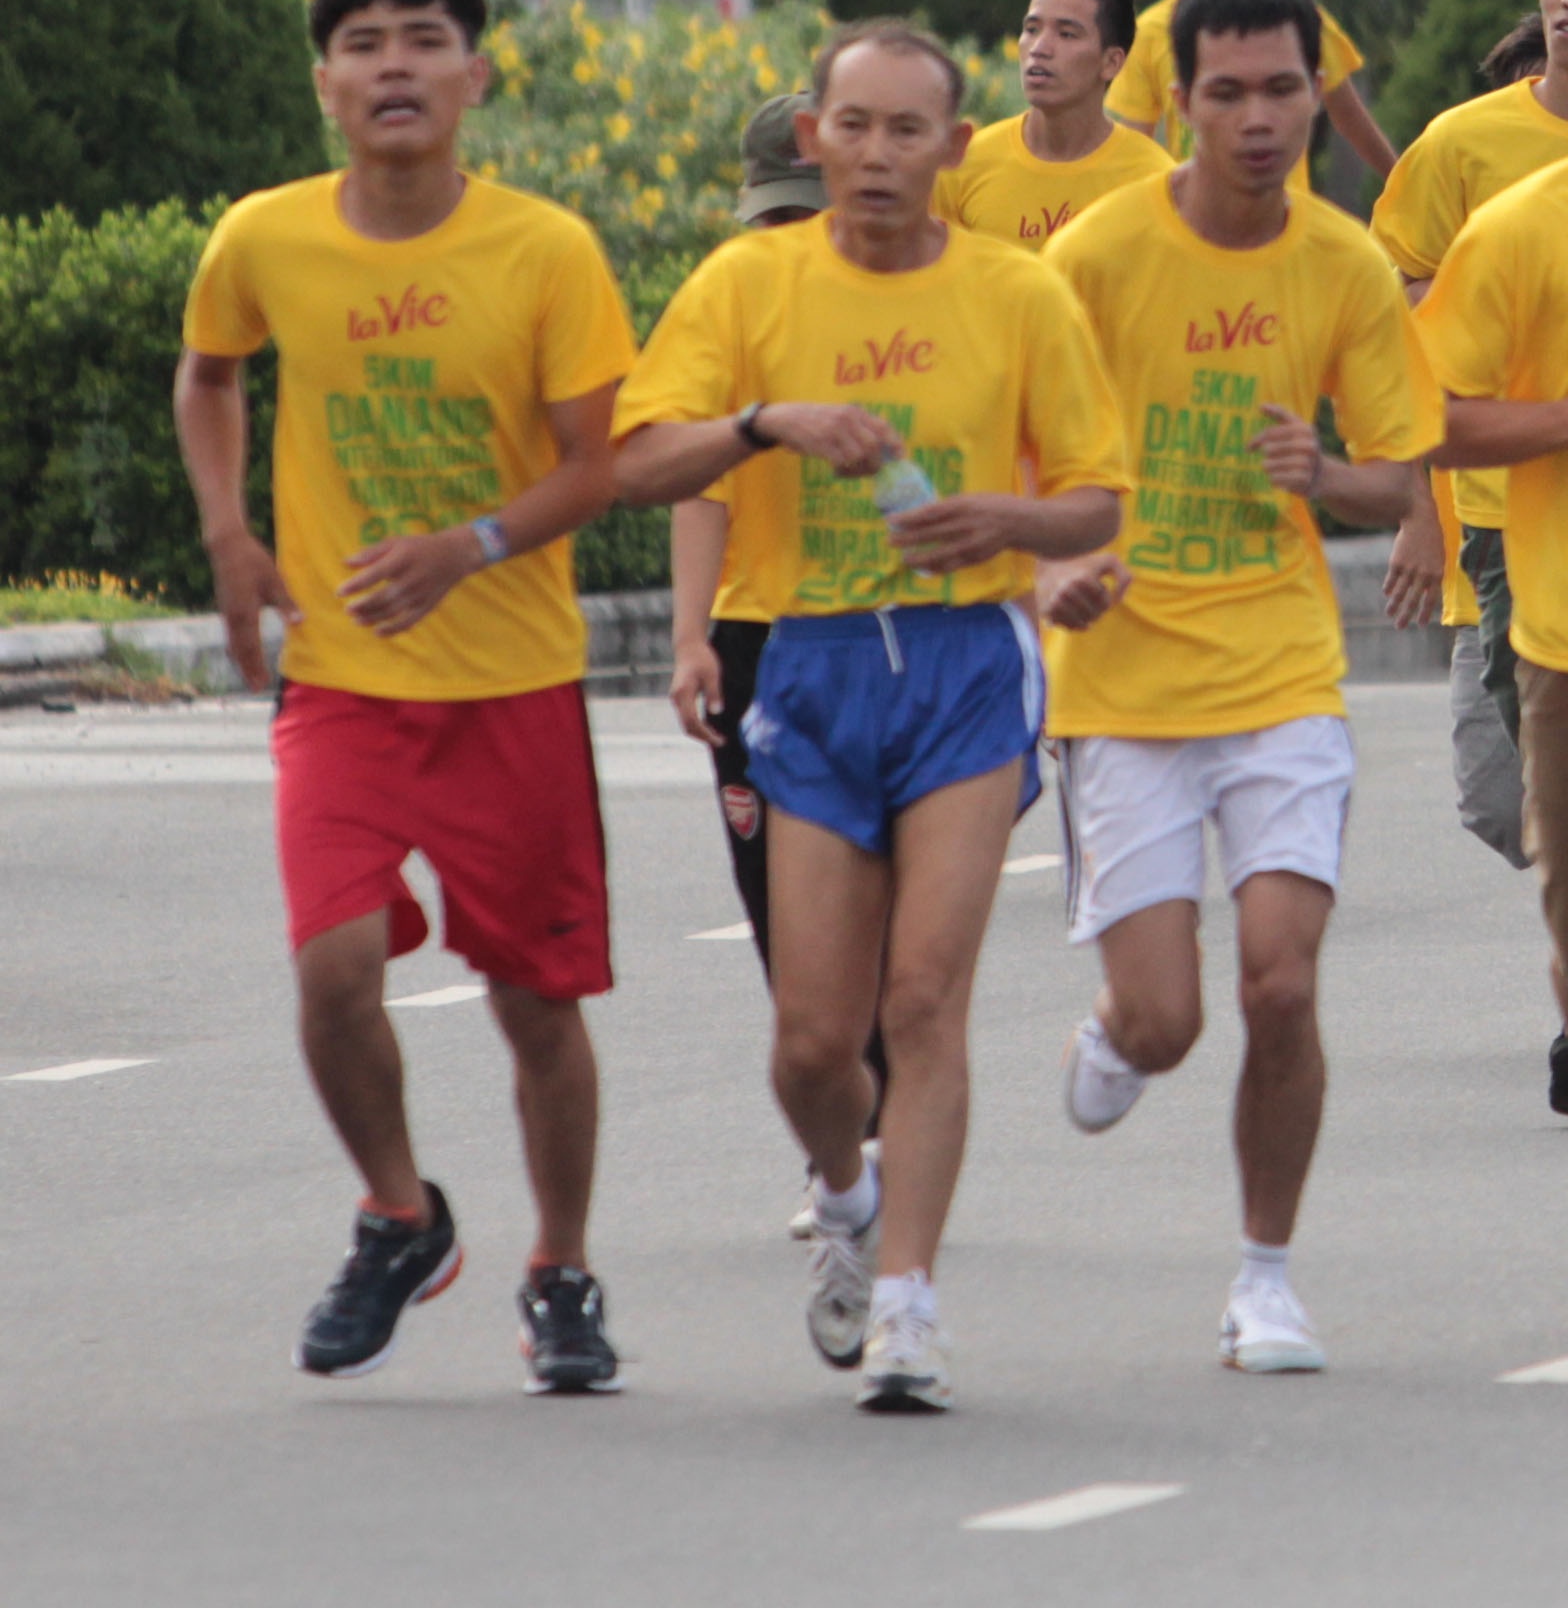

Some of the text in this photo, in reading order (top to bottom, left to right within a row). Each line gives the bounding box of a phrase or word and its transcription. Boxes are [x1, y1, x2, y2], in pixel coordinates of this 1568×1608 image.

[363, 355, 436, 389] 5KM
[1191, 368, 1259, 409] 5KM
[326, 391, 496, 442] DANANG
[1142, 402, 1274, 461] DANA
[1135, 484, 1281, 533] MARATHON
[1129, 530, 1280, 576] 2014
